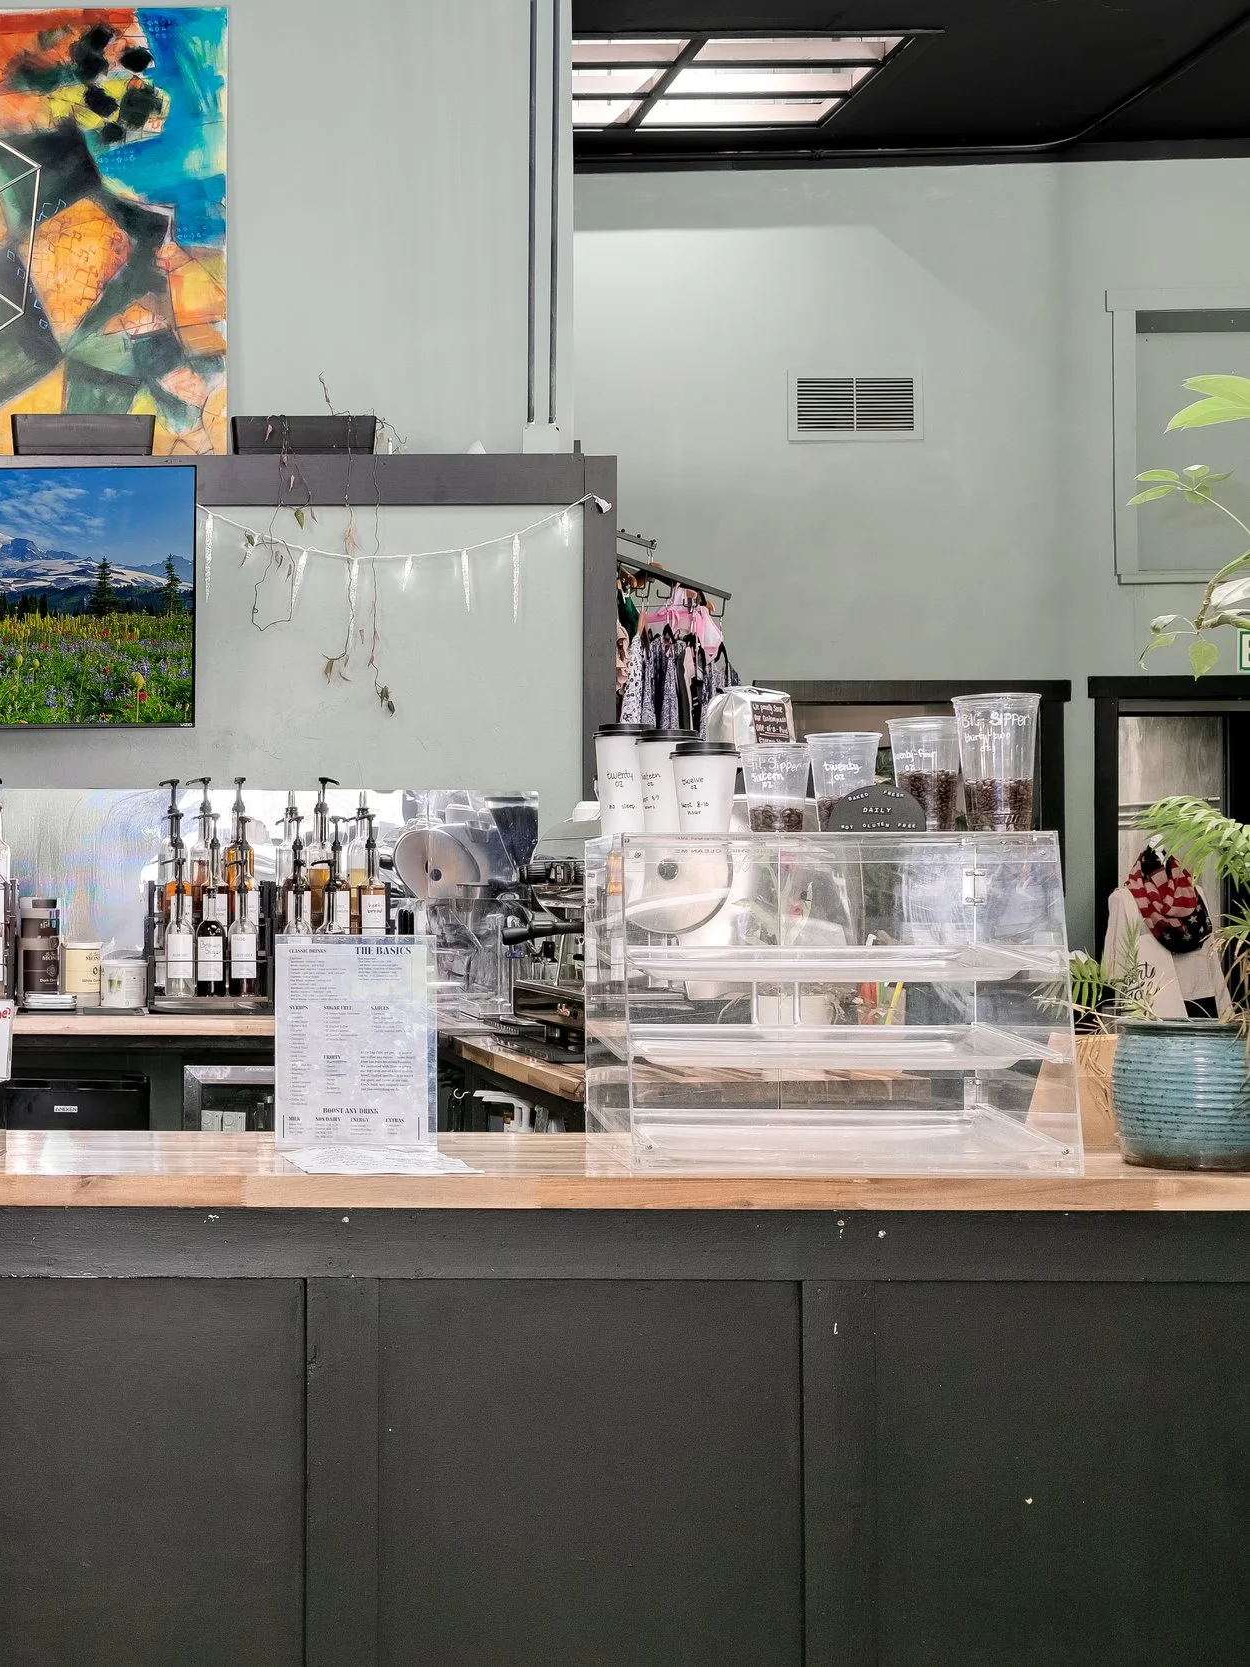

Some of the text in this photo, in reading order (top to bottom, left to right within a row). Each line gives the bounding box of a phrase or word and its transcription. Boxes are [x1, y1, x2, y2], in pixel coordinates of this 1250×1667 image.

[822, 761, 863, 775] twenty
[606, 770, 634, 781] twenty
[641, 772, 662, 781] ixteen
[681, 777, 704, 786] twelve
[848, 790, 905, 802] BAKED FRESH
[355, 946, 412, 955] THE BASICS
